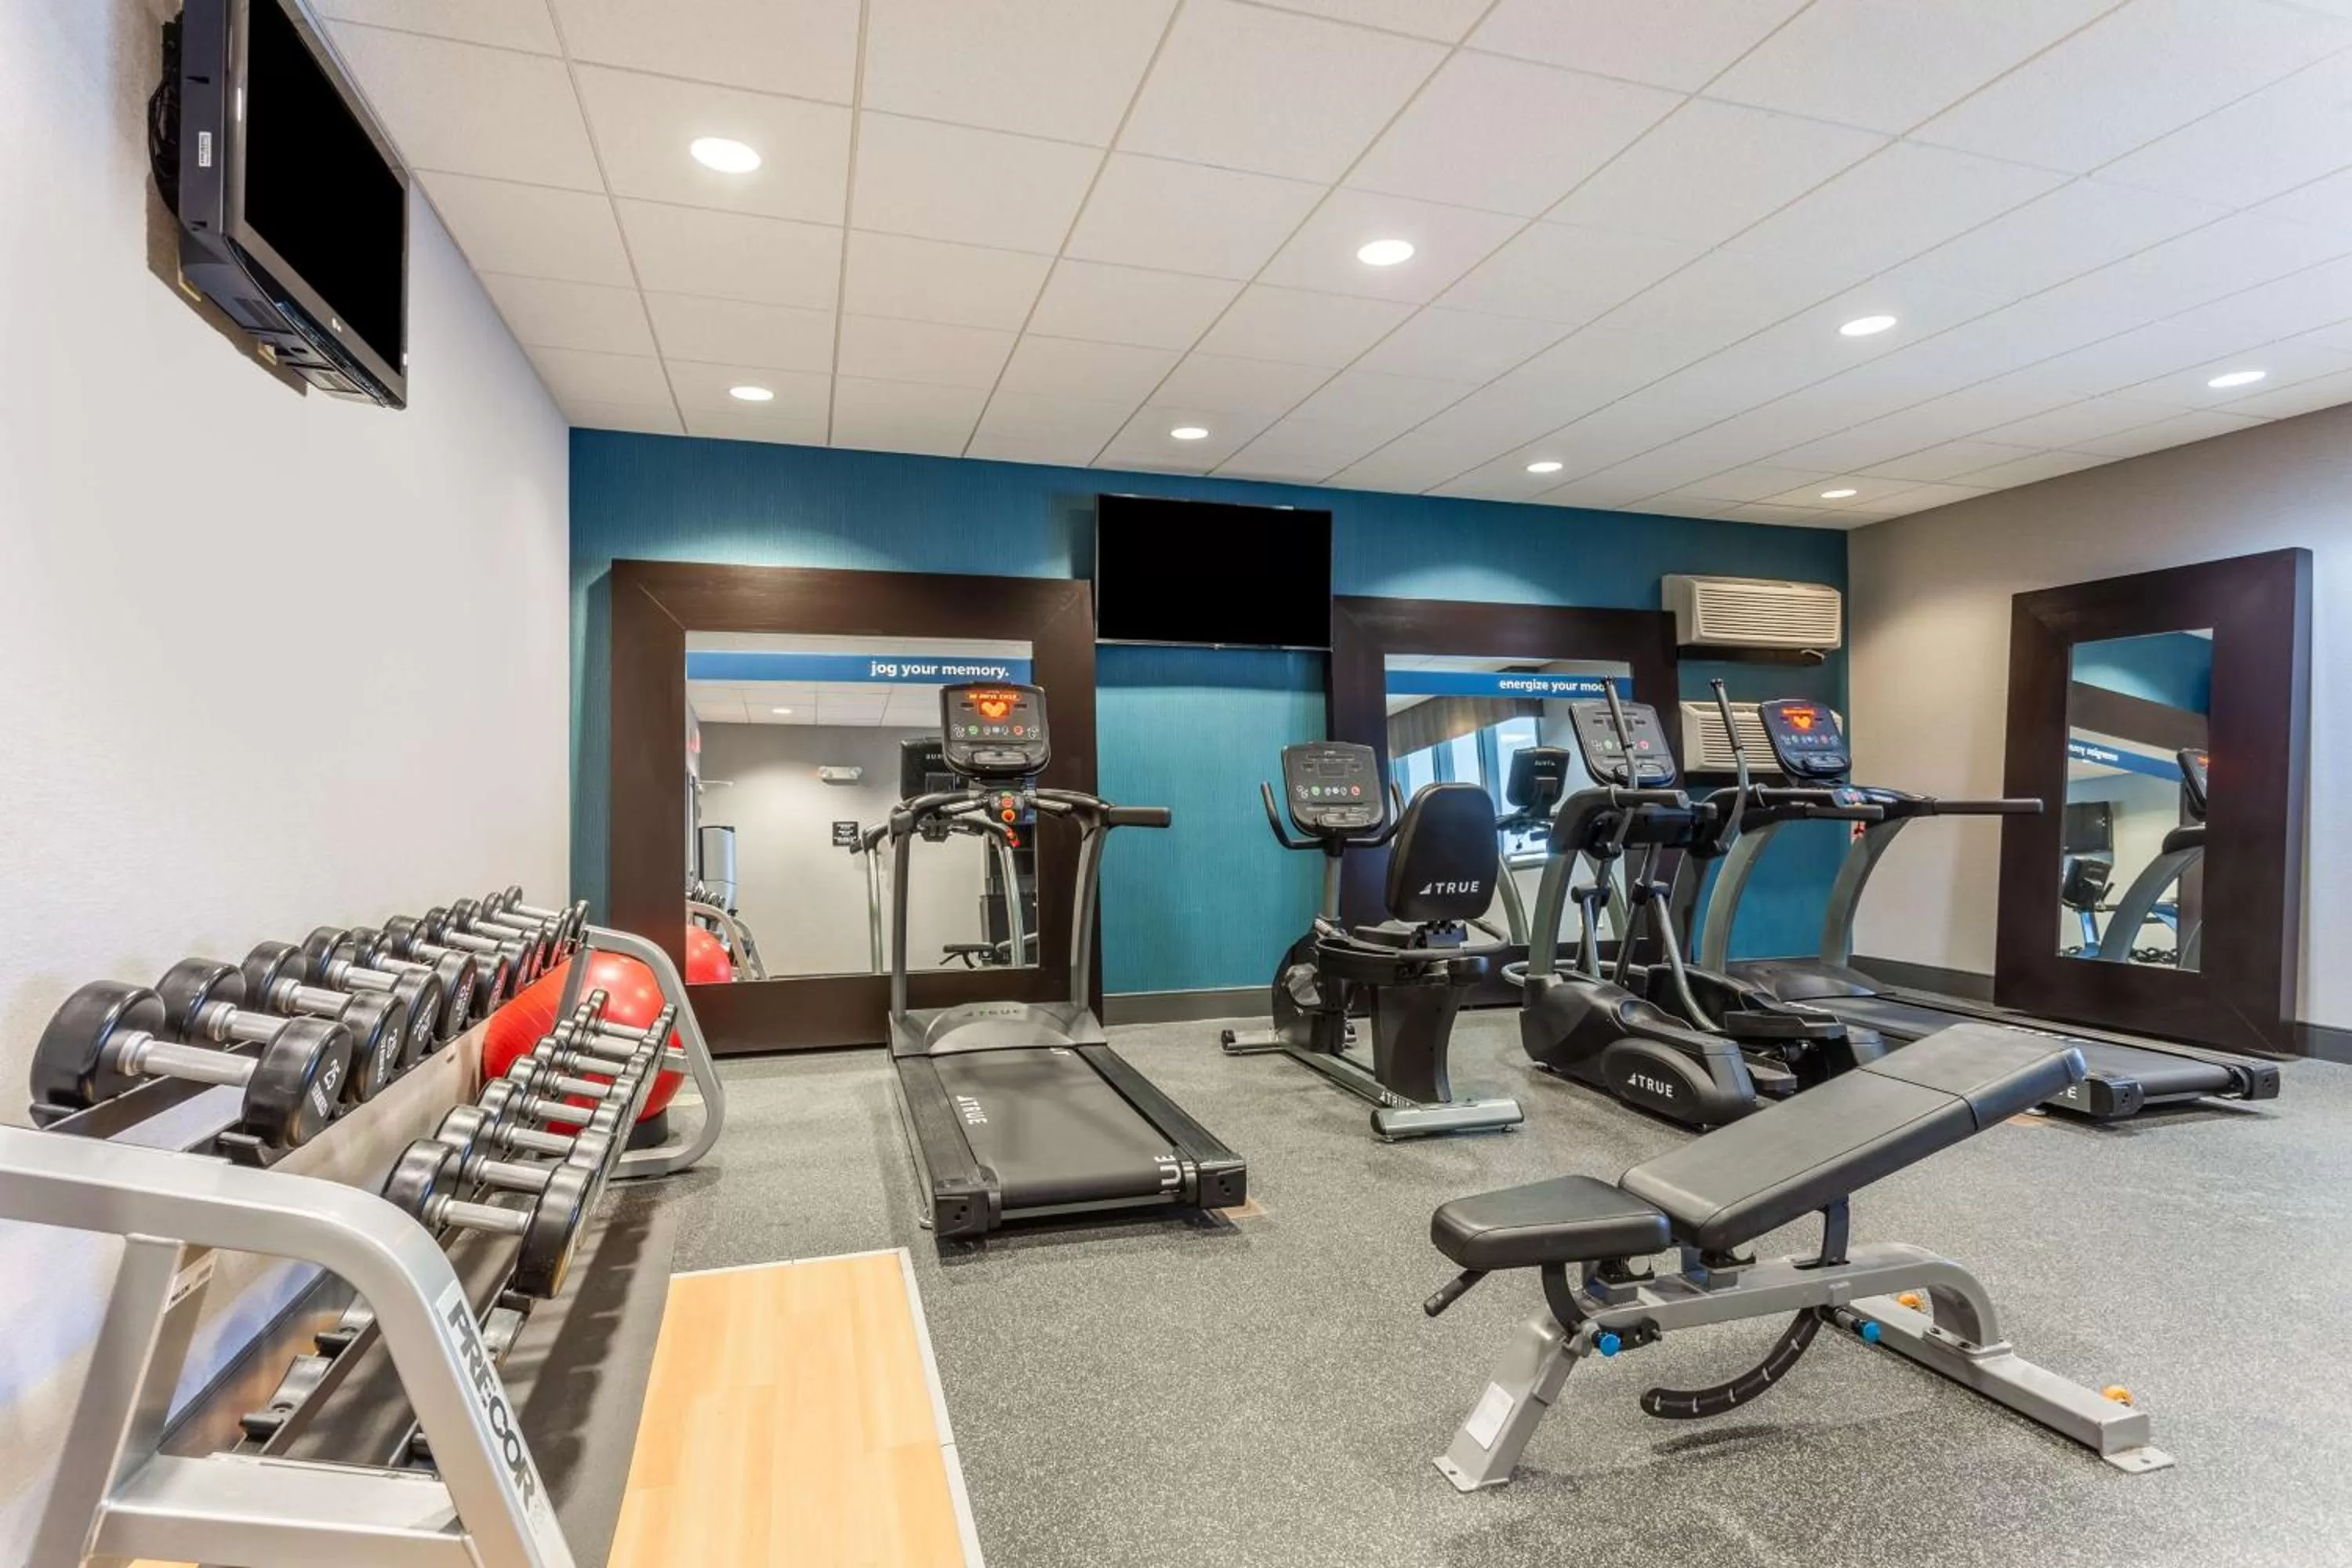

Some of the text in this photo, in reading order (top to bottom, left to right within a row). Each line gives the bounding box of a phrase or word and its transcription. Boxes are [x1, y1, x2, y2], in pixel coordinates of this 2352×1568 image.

[870, 661, 1010, 680] jog your memory.
[1499, 679, 1606, 694] energize your moo
[1435, 880, 1480, 895] TRUE
[1637, 1074, 1674, 1098] TRUE
[959, 1100, 989, 1125] TRUE
[447, 1299, 535, 1512] PRECOR
